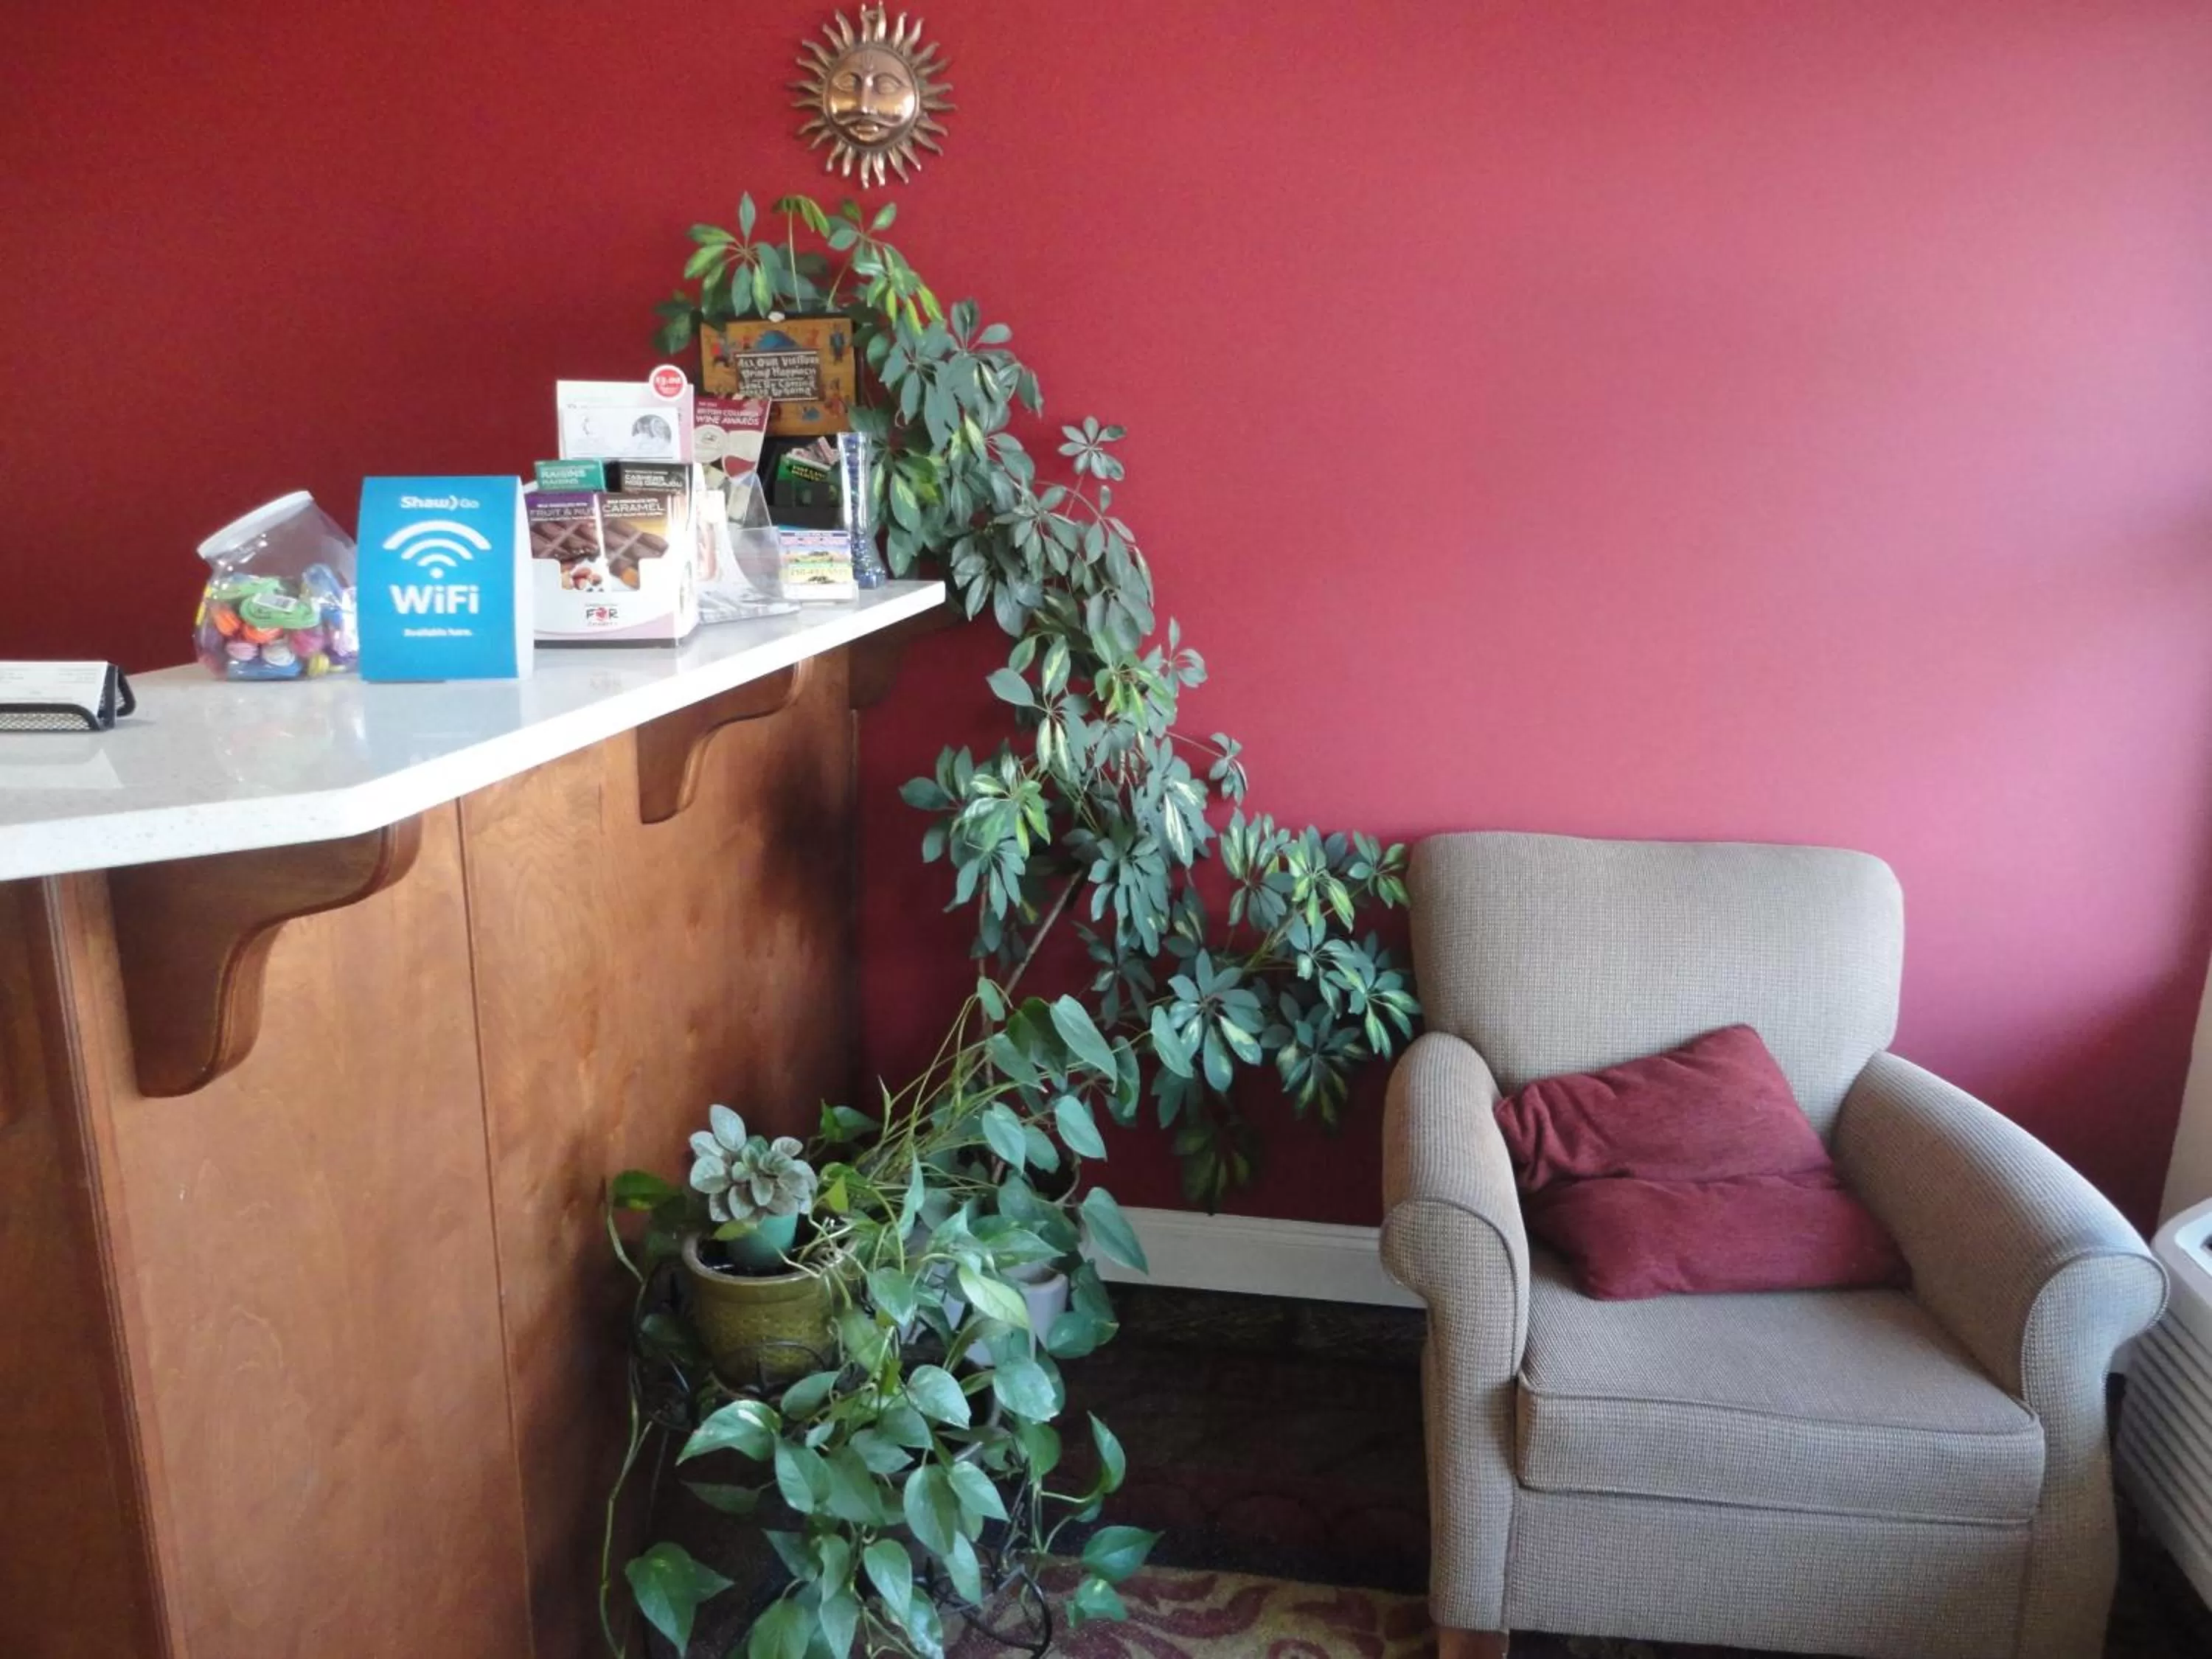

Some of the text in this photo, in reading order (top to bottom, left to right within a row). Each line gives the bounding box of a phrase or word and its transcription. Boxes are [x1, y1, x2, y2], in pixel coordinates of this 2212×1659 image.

[695, 415, 760, 425] WINE AWARDS
[529, 507, 563, 518] FRUIT
[602, 502, 666, 513] CARAMEL
[389, 584, 480, 615] WiFi
